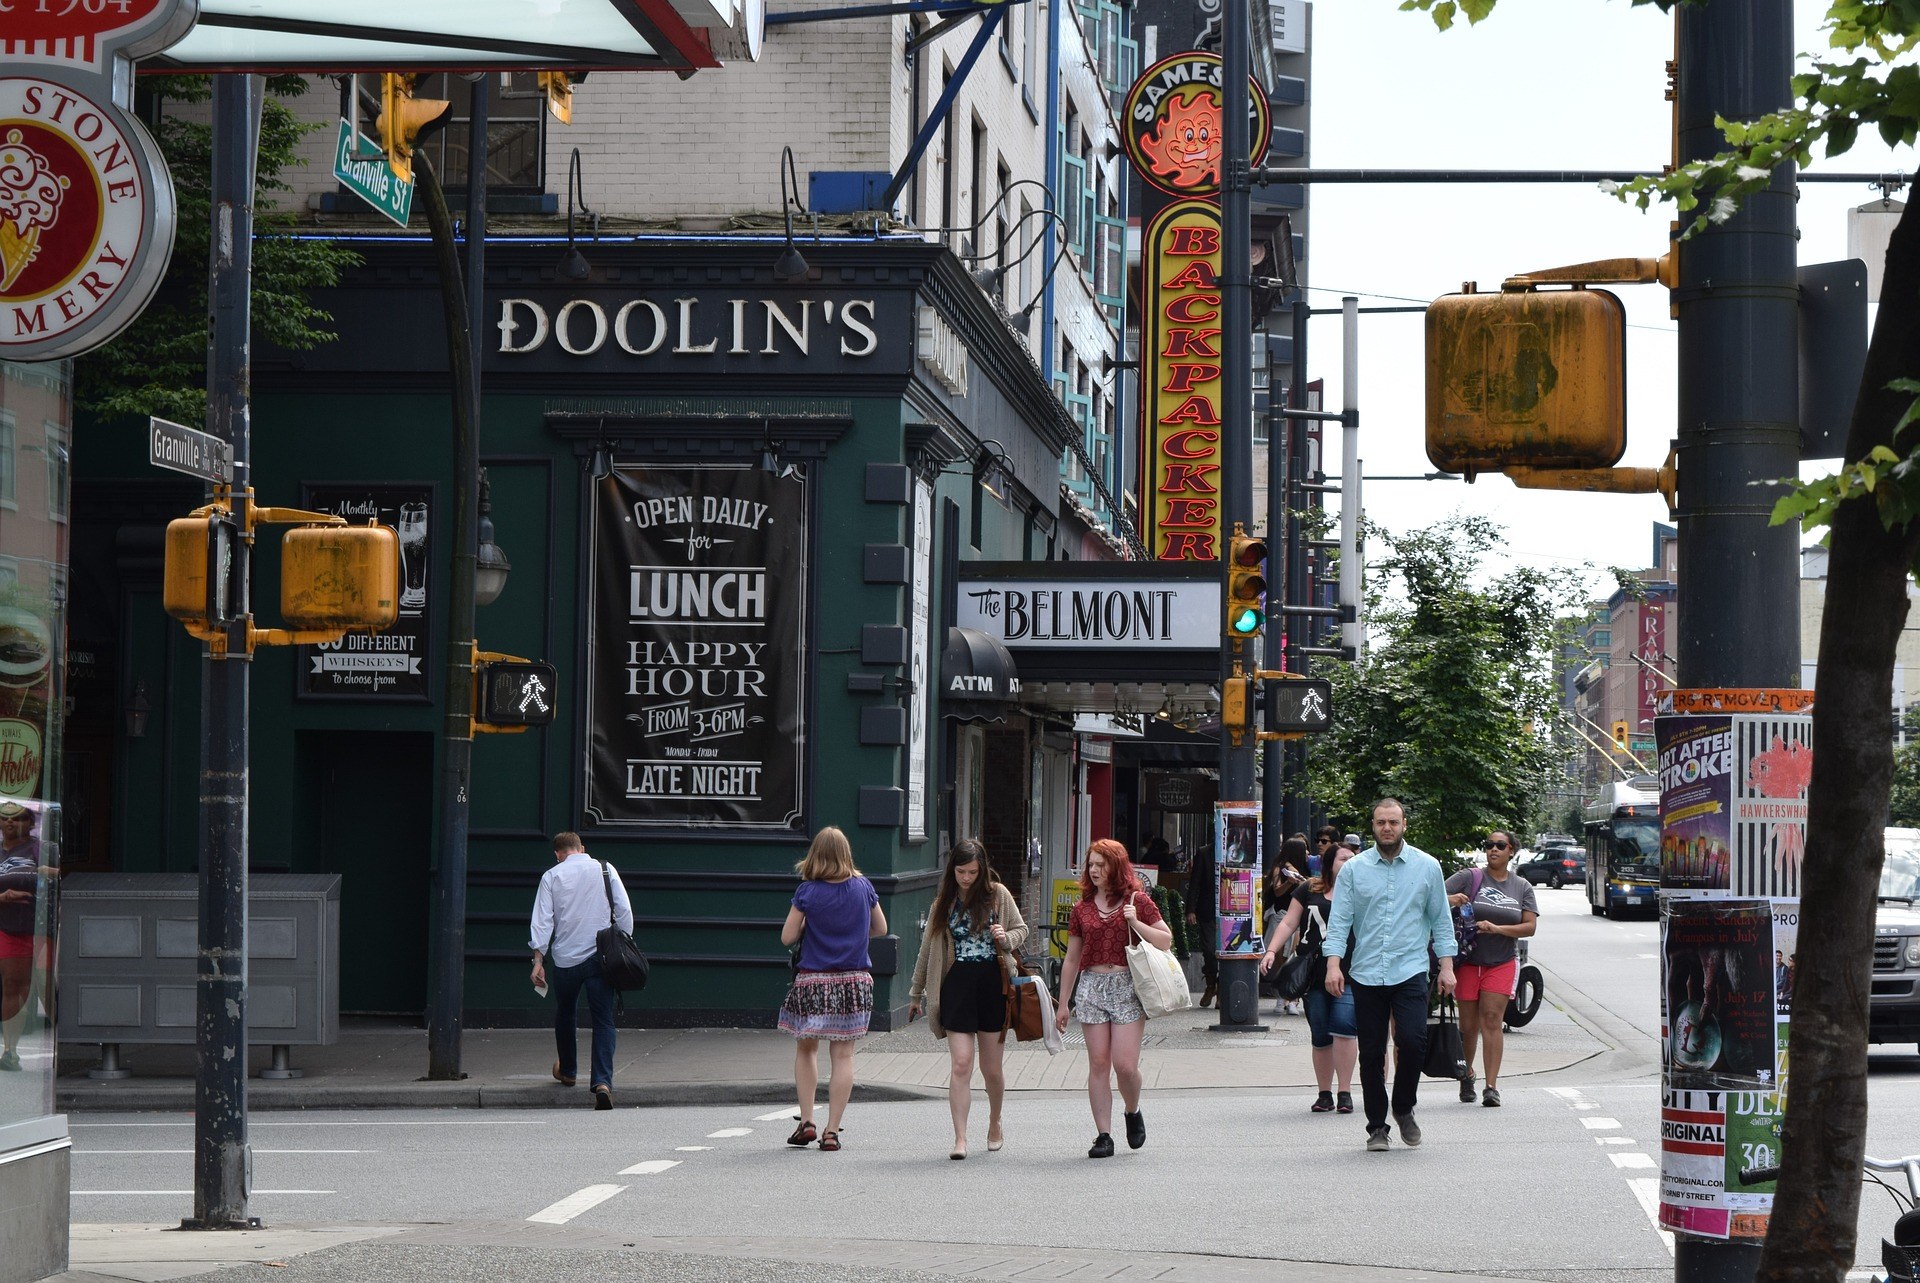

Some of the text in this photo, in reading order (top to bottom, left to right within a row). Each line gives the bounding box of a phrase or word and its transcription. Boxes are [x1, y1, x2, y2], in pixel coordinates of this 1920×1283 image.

[22, 86, 137, 203] STONE
[392, 177, 407, 214] St
[497, 297, 878, 355] DOOLIN'S
[1159, 227, 1222, 561] BACKPACKER
[154, 428, 199, 469] Granville
[331, 500, 379, 518] Monthly
[633, 496, 769, 530] OPEN DAILY
[687, 526, 712, 561] for
[630, 571, 765, 618] LUNCH
[968, 588, 1001, 617] The
[1003, 590, 1177, 641] BELMONT
[348, 635, 416, 651] DIFFERENT
[626, 641, 768, 667] HAPPY
[328, 657, 405, 668] WHISKEYS
[1644, 617, 1660, 706] RAMADA
[333, 671, 396, 692] to choose from
[624, 668, 768, 697] HOUR
[950, 675, 993, 692] ATM
[1703, 694, 1780, 706] REMOVED
[646, 704, 745, 737] FROM 3-6PM
[1659, 747, 1676, 772] ART
[1679, 732, 1731, 761] AFTER
[626, 765, 761, 796] LATE NIGHT
[1659, 750, 1731, 796] STROKE
[1628, 806, 1634, 816] 4
[1231, 882, 1249, 894] SHINE
[1733, 928, 1759, 946] July
[1724, 991, 1747, 1007] July
[1661, 1121, 1725, 1143] ORIGINAL
[1686, 1191, 1715, 1201] STREET
